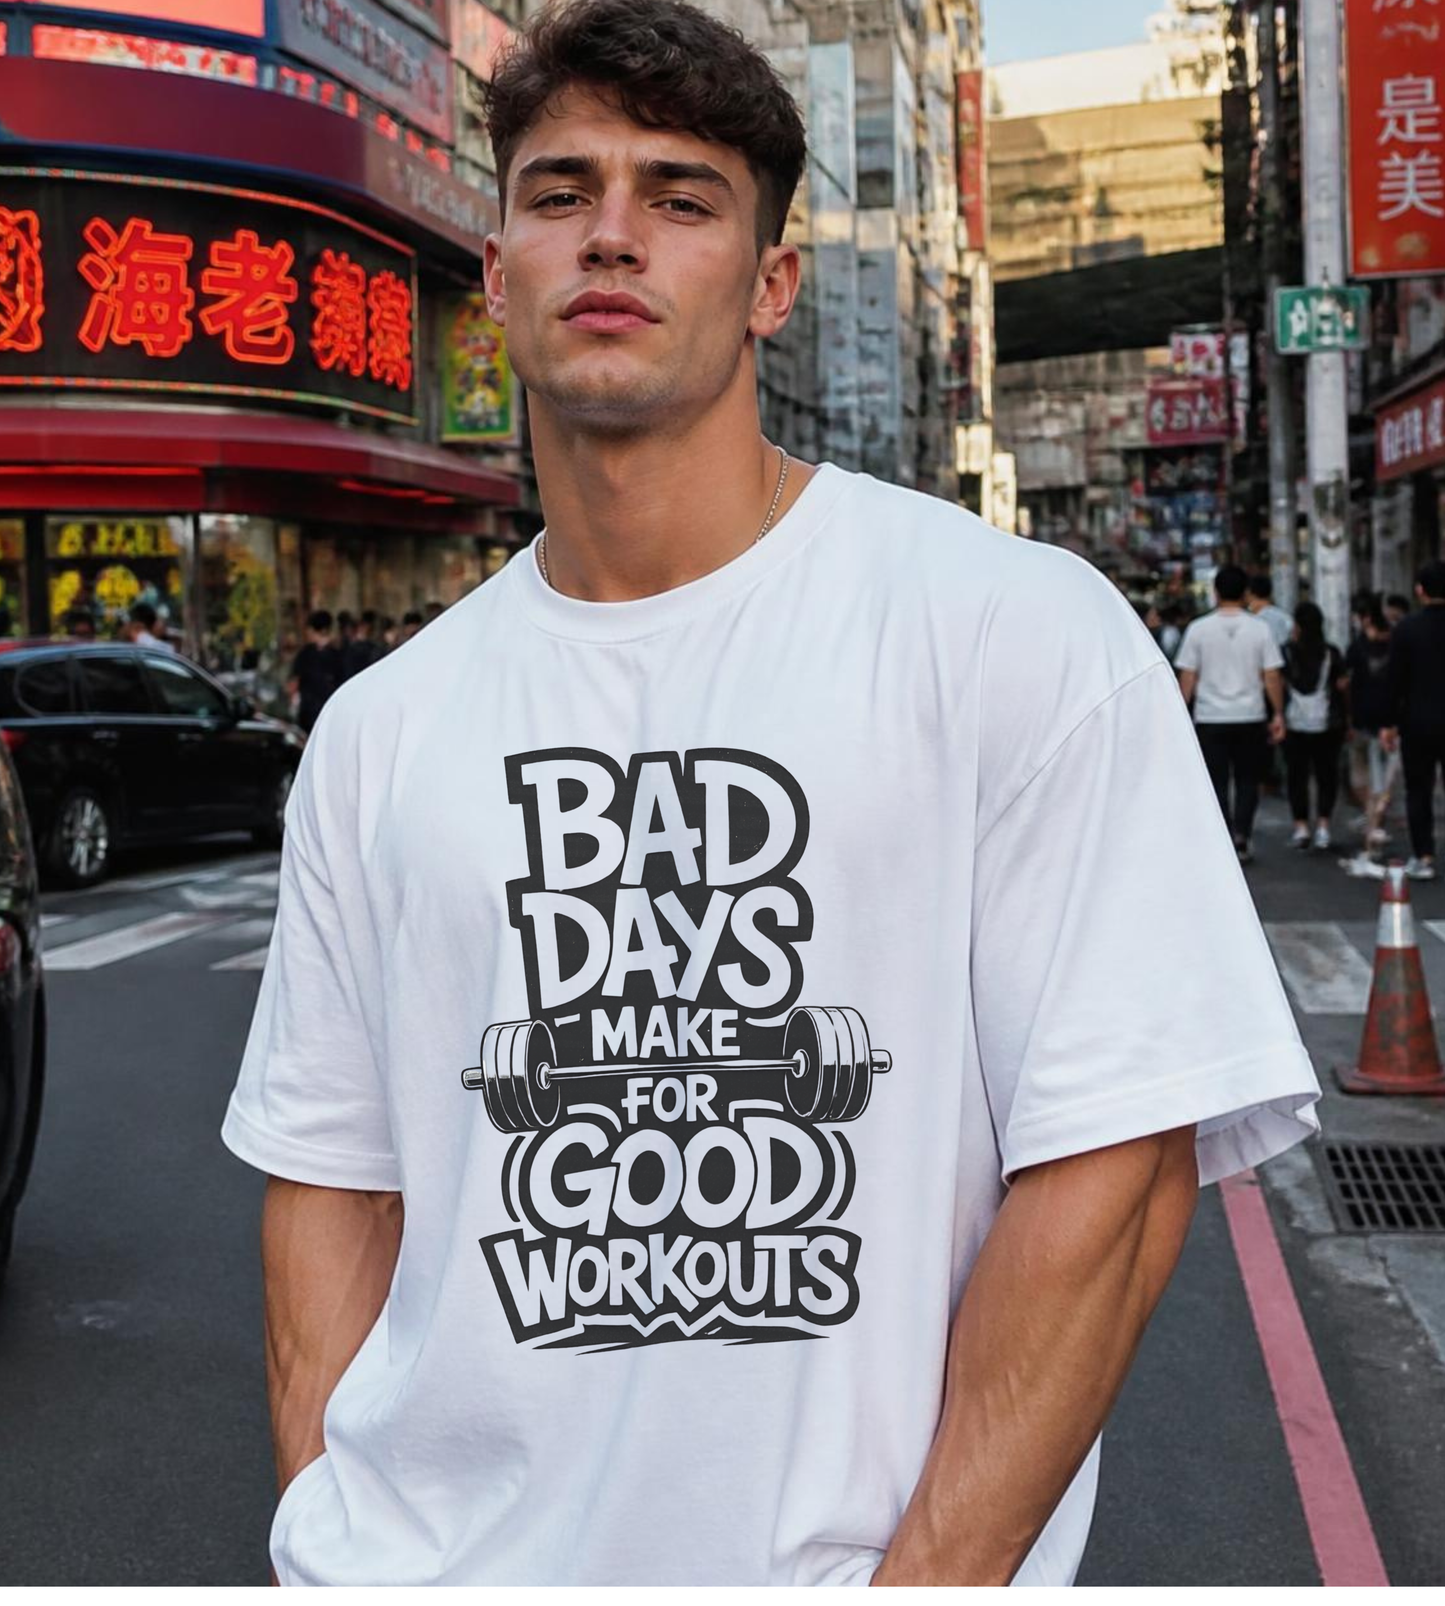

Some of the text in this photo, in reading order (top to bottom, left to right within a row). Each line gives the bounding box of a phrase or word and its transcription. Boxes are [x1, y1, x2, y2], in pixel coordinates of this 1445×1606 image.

[1376, 73, 1445, 221] 是美
[521, 760, 796, 891] BAD
[522, 886, 798, 1009] DAYS
[591, 1005, 740, 1060] MAKE
[621, 1074, 719, 1124] FOR
[530, 1117, 823, 1236] GOOD
[494, 1233, 849, 1327] WORKOUTS
